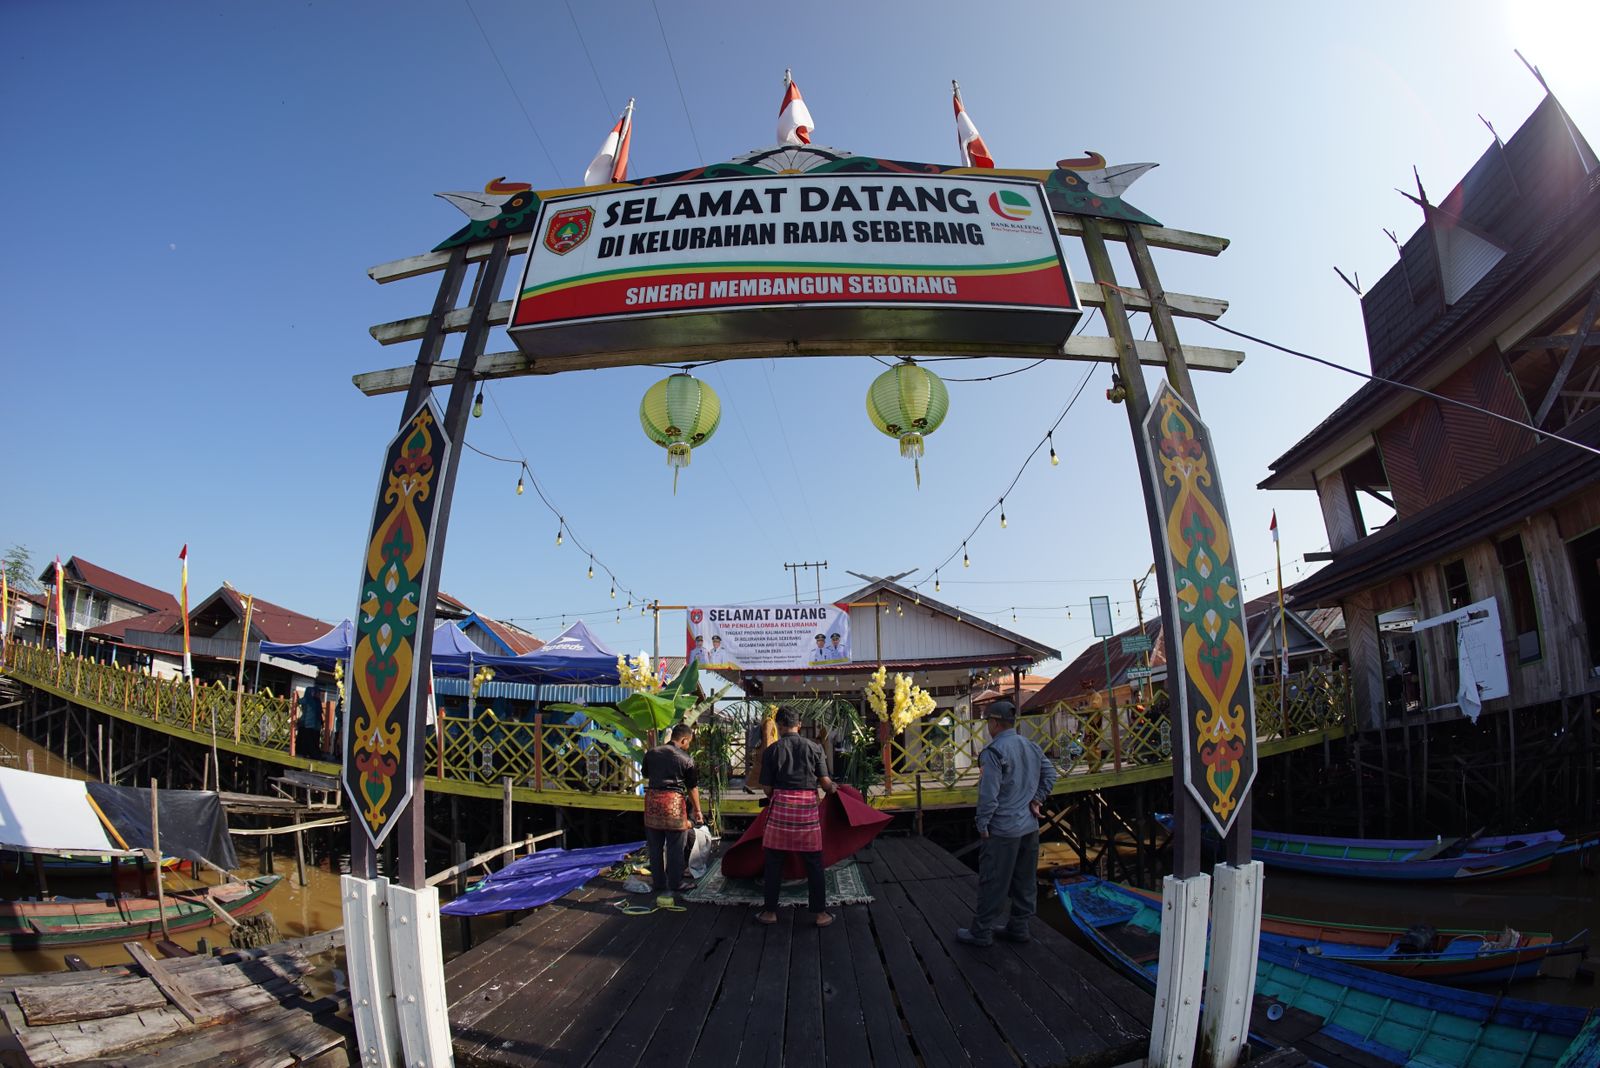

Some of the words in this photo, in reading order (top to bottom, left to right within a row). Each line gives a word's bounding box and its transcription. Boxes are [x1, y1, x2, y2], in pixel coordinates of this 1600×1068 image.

[603, 187, 788, 228] SELAMAT
[799, 185, 980, 215] DATANG
[597, 235, 625, 259] DI
[629, 222, 776, 256] KELURAHAN
[783, 220, 848, 244] RAJA
[853, 220, 985, 246] SEBERANG
[625, 281, 705, 306] SINERGI
[709, 276, 844, 299] MEMBANGUN
[848, 275, 958, 295] SEBORANG
[709, 608, 771, 622] SELAMAT
[775, 607, 827, 620] DATANG
